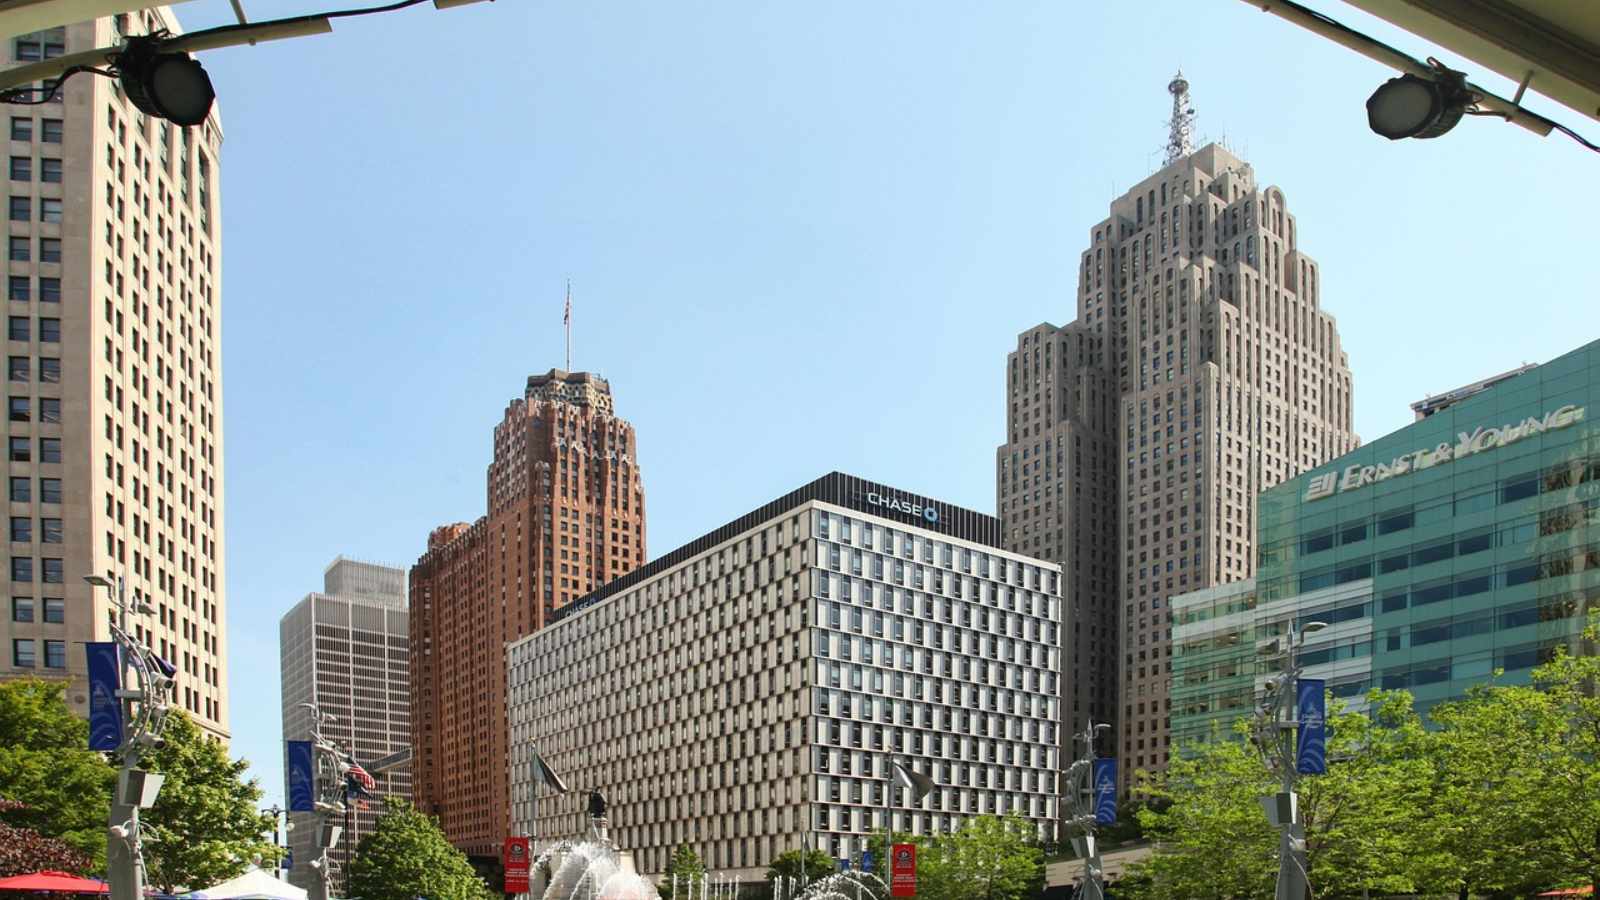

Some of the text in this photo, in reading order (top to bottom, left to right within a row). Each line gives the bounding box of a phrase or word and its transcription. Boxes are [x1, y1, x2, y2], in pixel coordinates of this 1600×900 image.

[1343, 448, 1428, 489] ERNST
[1433, 442, 1454, 463] &
[1456, 404, 1584, 455] YOUNG
[868, 492, 922, 517] CHASE
